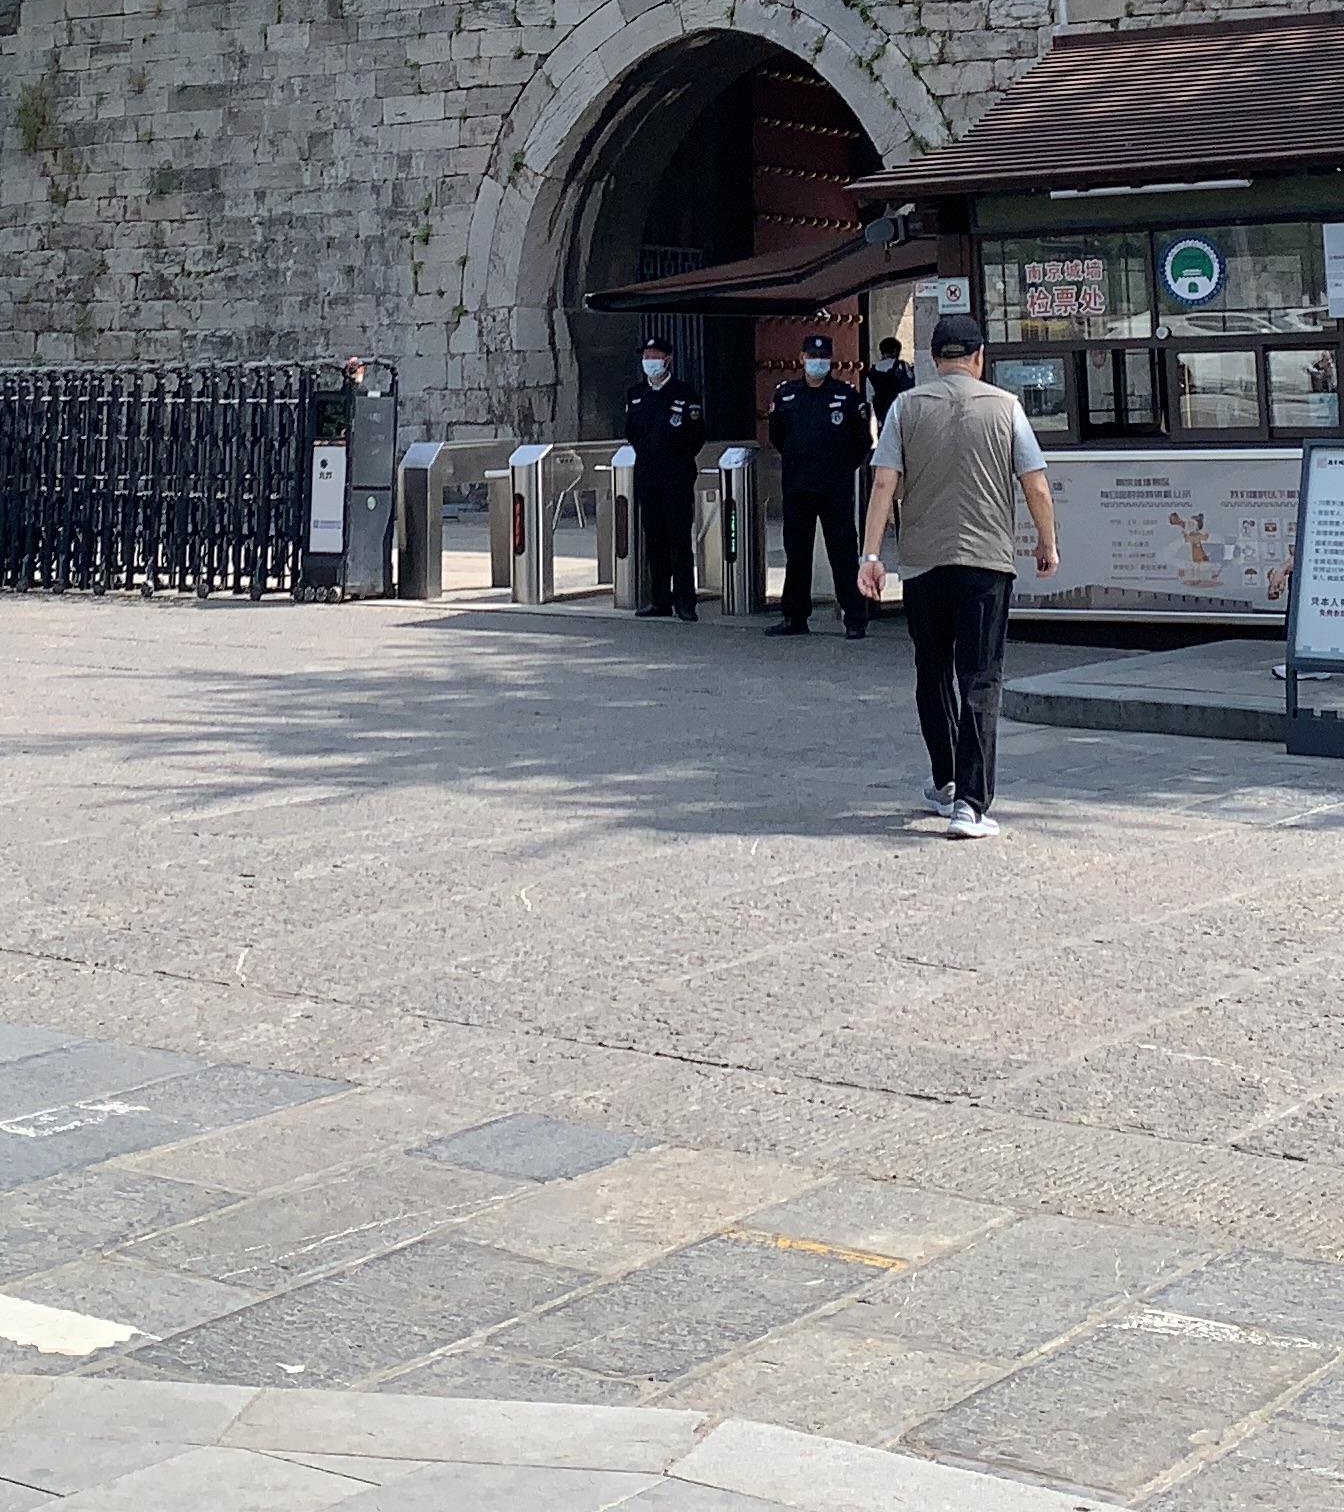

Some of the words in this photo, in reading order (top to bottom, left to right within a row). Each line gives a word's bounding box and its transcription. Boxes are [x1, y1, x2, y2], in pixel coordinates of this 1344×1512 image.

[1025, 259, 1103, 284] 南京城墙
[1027, 285, 1106, 317] 检票处
